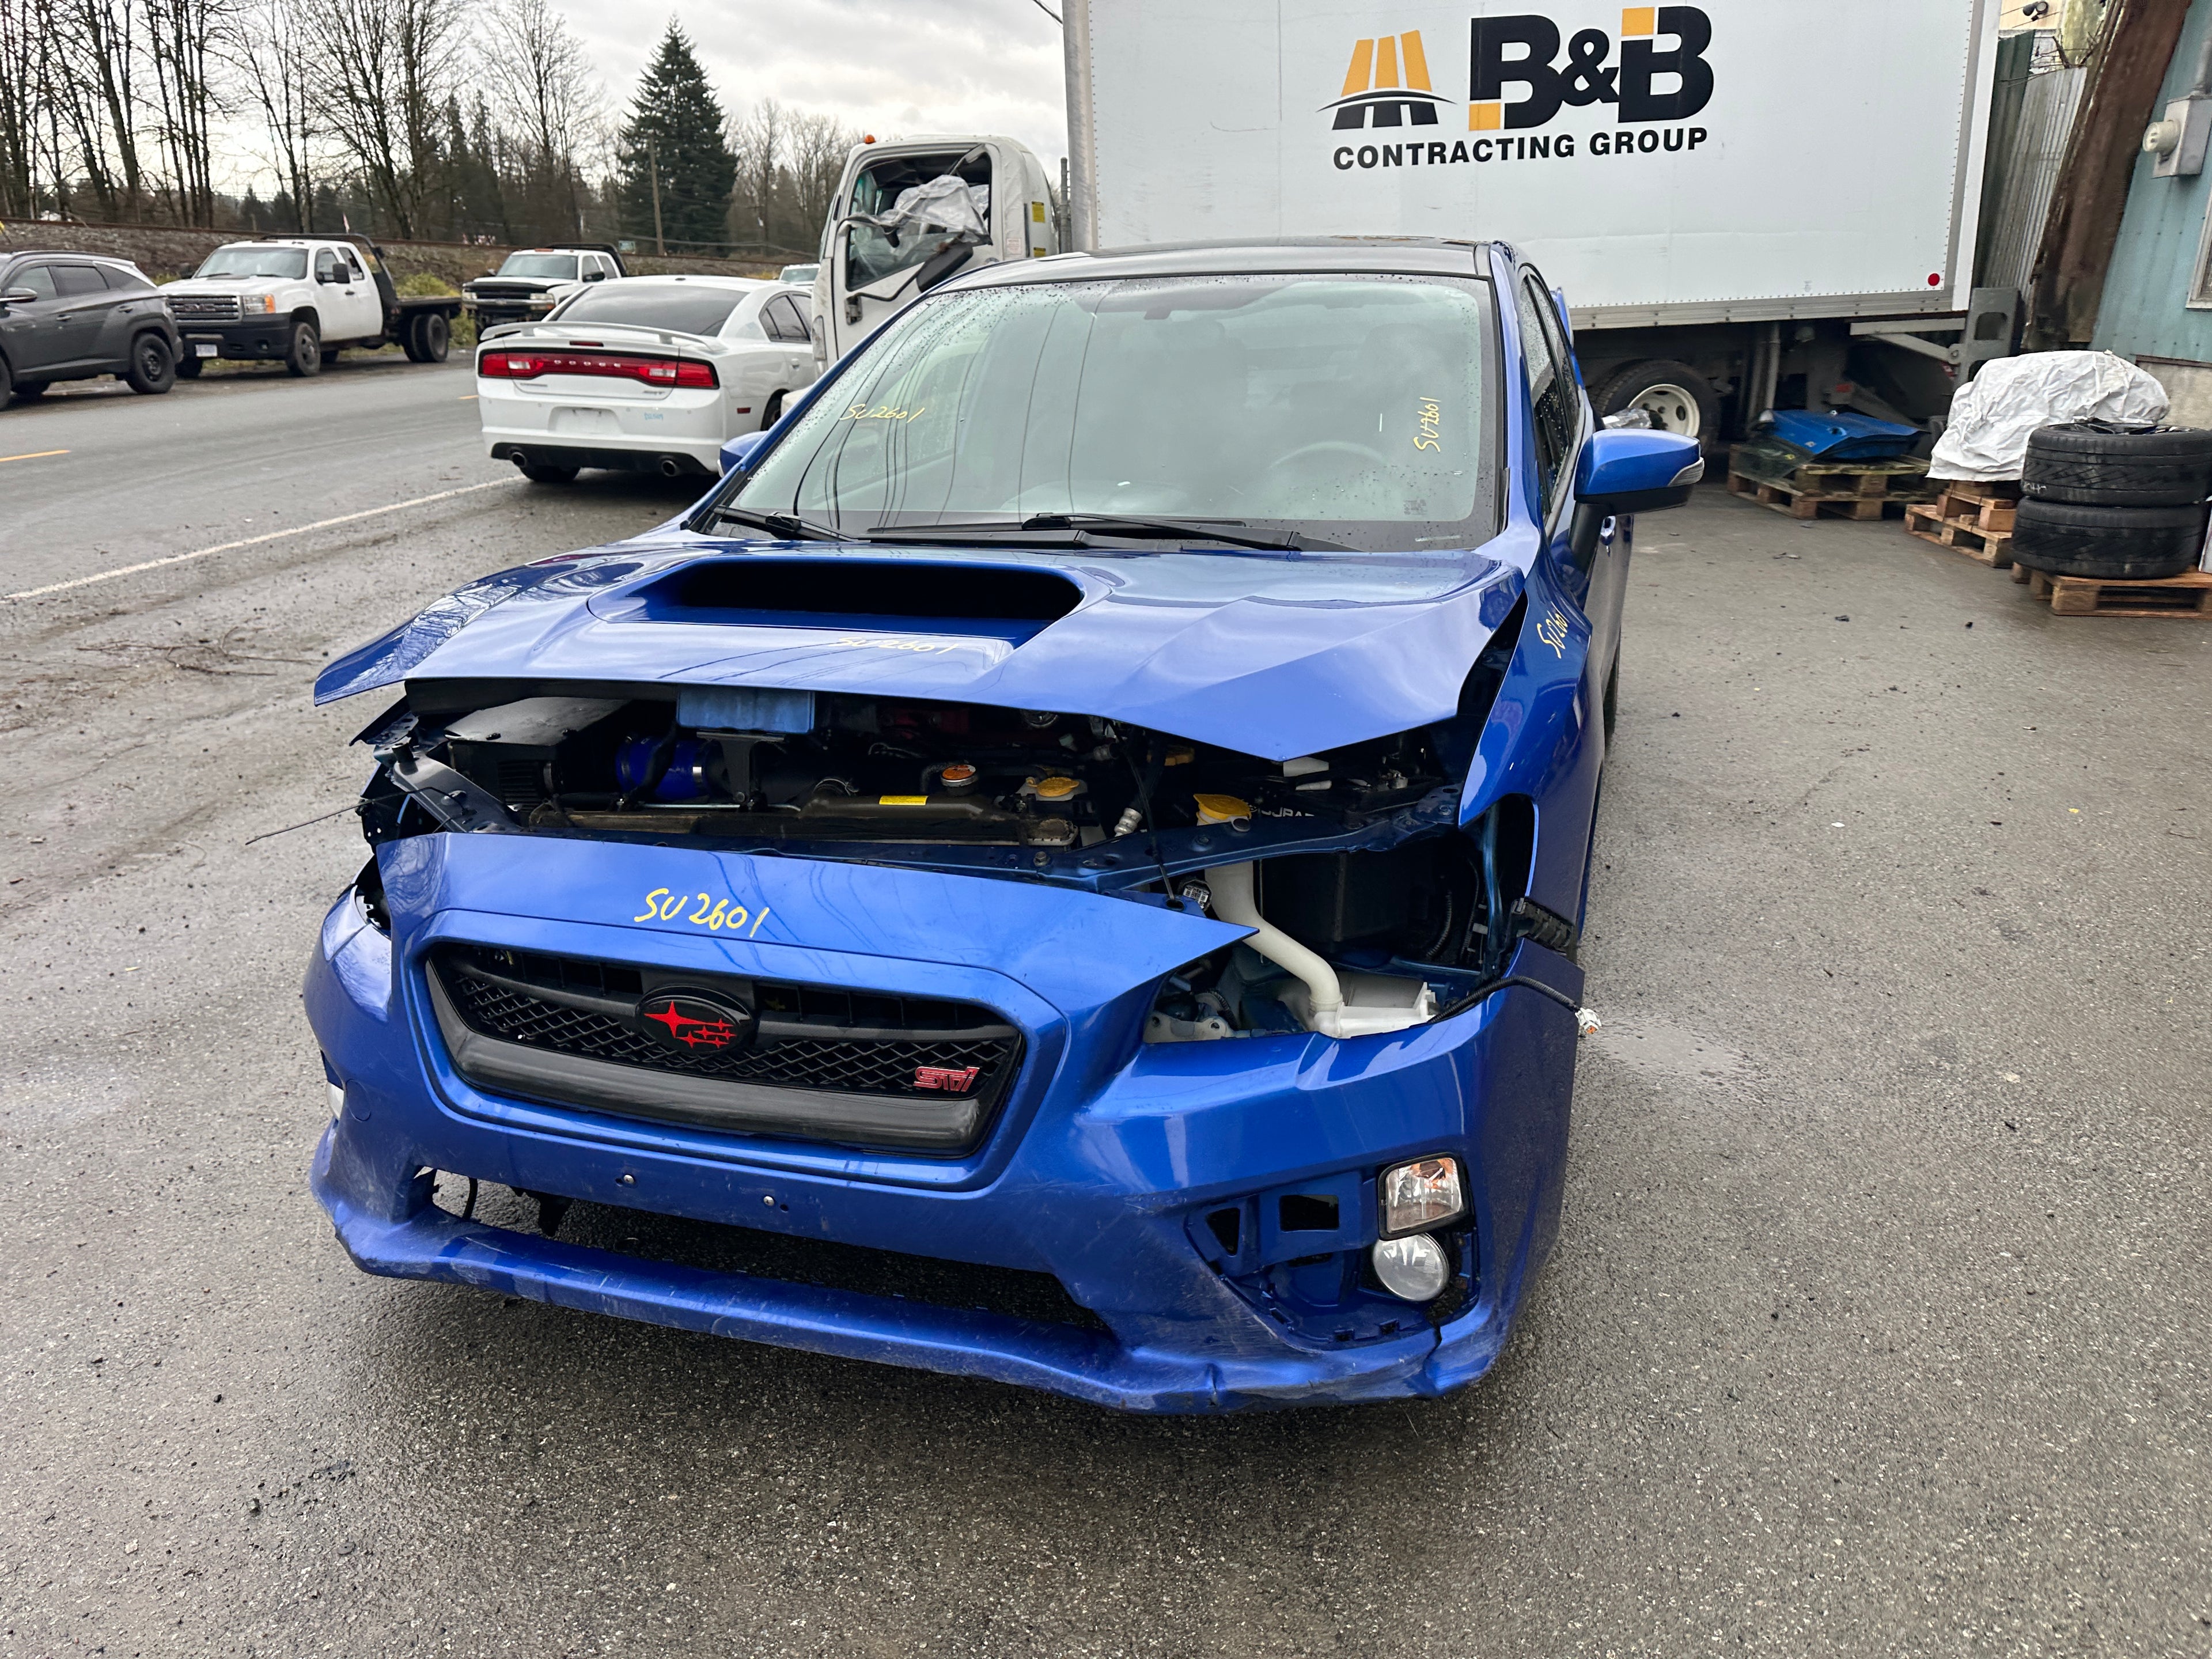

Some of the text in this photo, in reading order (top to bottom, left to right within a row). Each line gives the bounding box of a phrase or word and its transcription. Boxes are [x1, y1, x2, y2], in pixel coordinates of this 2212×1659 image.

[1469, 6, 1714, 131] B&B
[1333, 127, 1707, 170] CONTRACTING GROUP
[839, 403, 925, 423] SU2601
[828, 637, 959, 654] SU2601
[634, 888, 770, 938] SU2601
